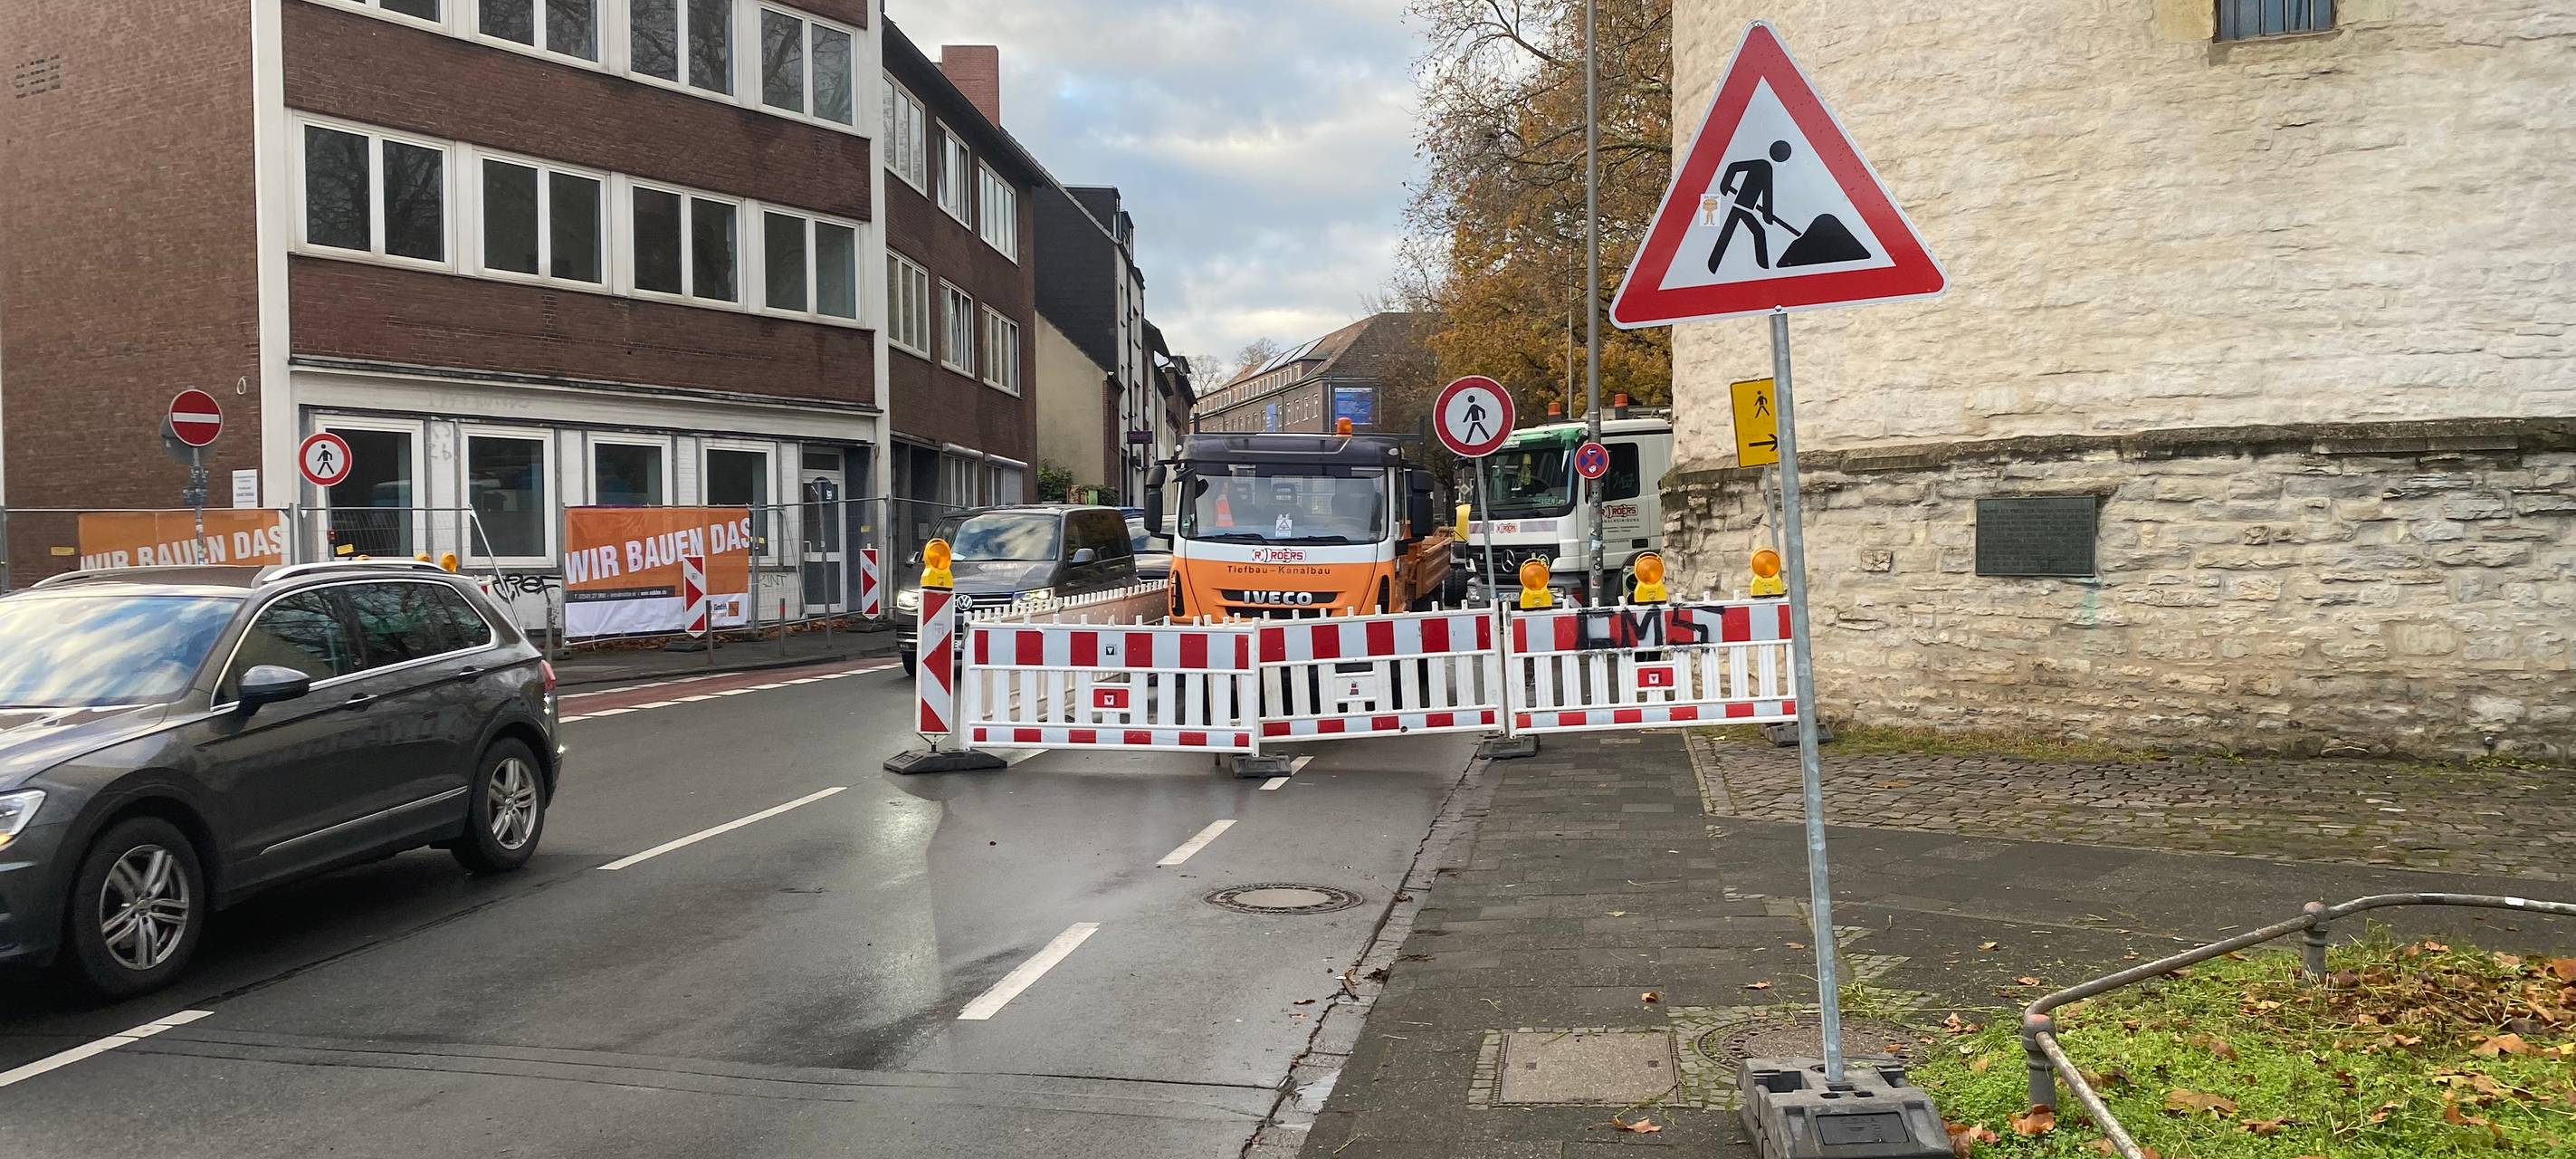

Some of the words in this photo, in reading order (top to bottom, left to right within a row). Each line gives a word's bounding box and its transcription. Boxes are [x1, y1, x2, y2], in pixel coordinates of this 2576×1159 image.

[233, 525, 282, 560] DAS
[565, 545, 620, 585] WIR
[625, 527, 704, 573] BAUEN
[710, 517, 750, 554] DAS
[1243, 590, 1313, 606] IVECO
